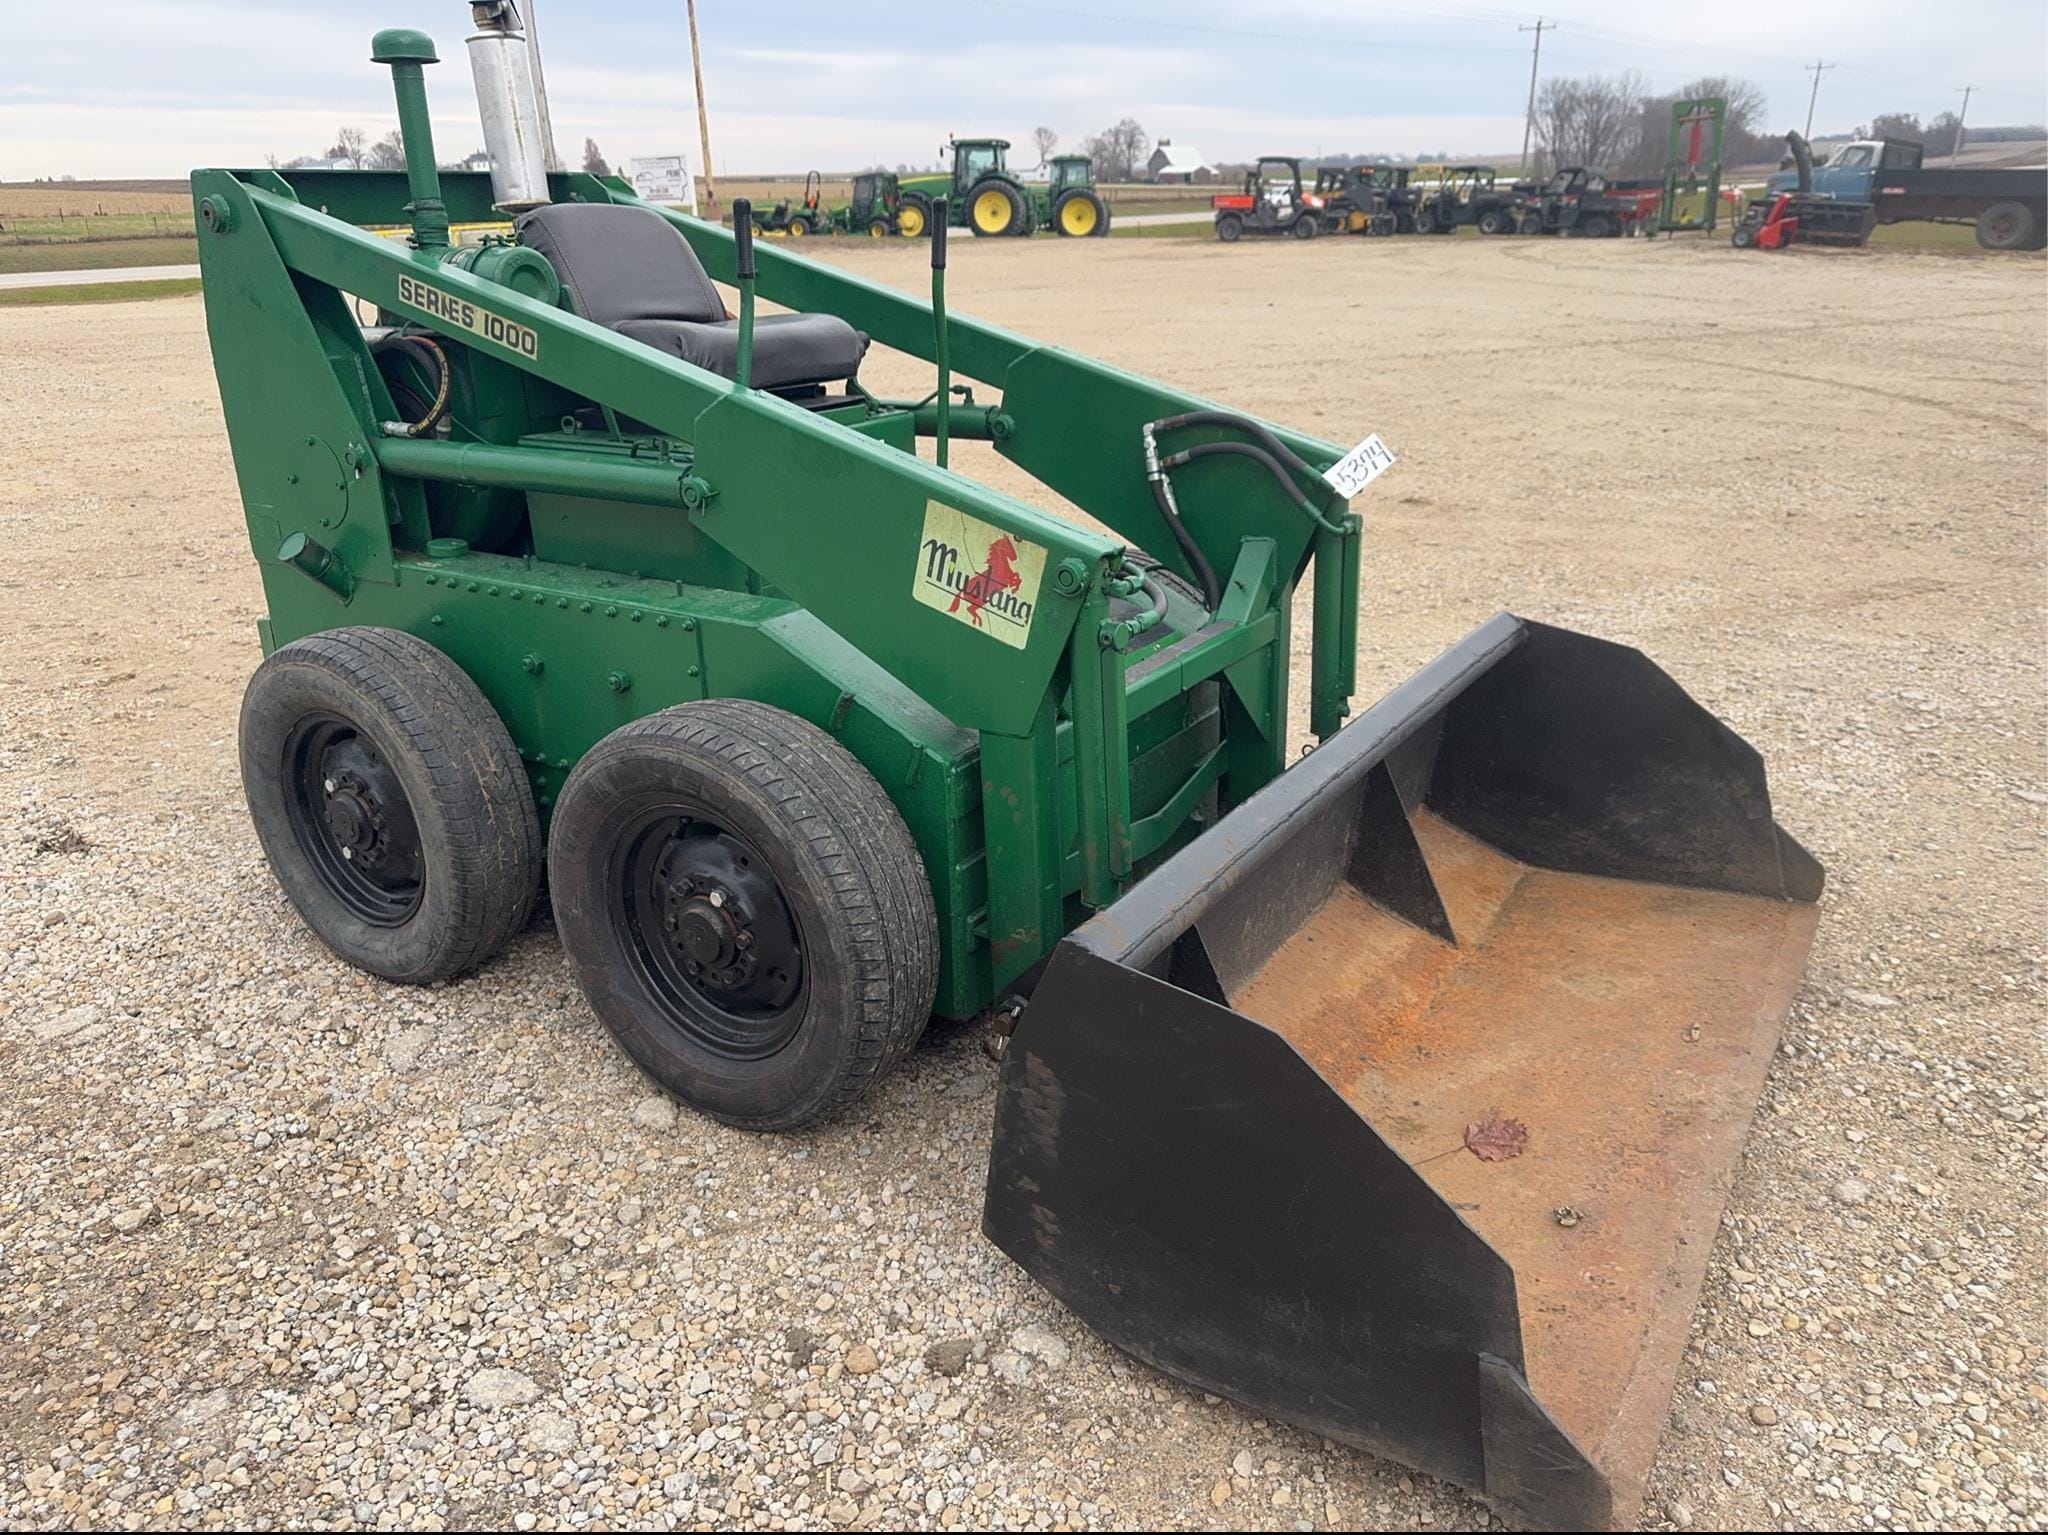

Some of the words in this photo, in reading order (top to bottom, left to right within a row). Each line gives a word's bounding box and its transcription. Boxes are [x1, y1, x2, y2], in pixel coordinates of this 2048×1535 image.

[401, 278, 474, 328] SERIES
[484, 313, 536, 355] 1000
[1337, 440, 1392, 491] 5394
[923, 539, 1032, 624] Mustang
